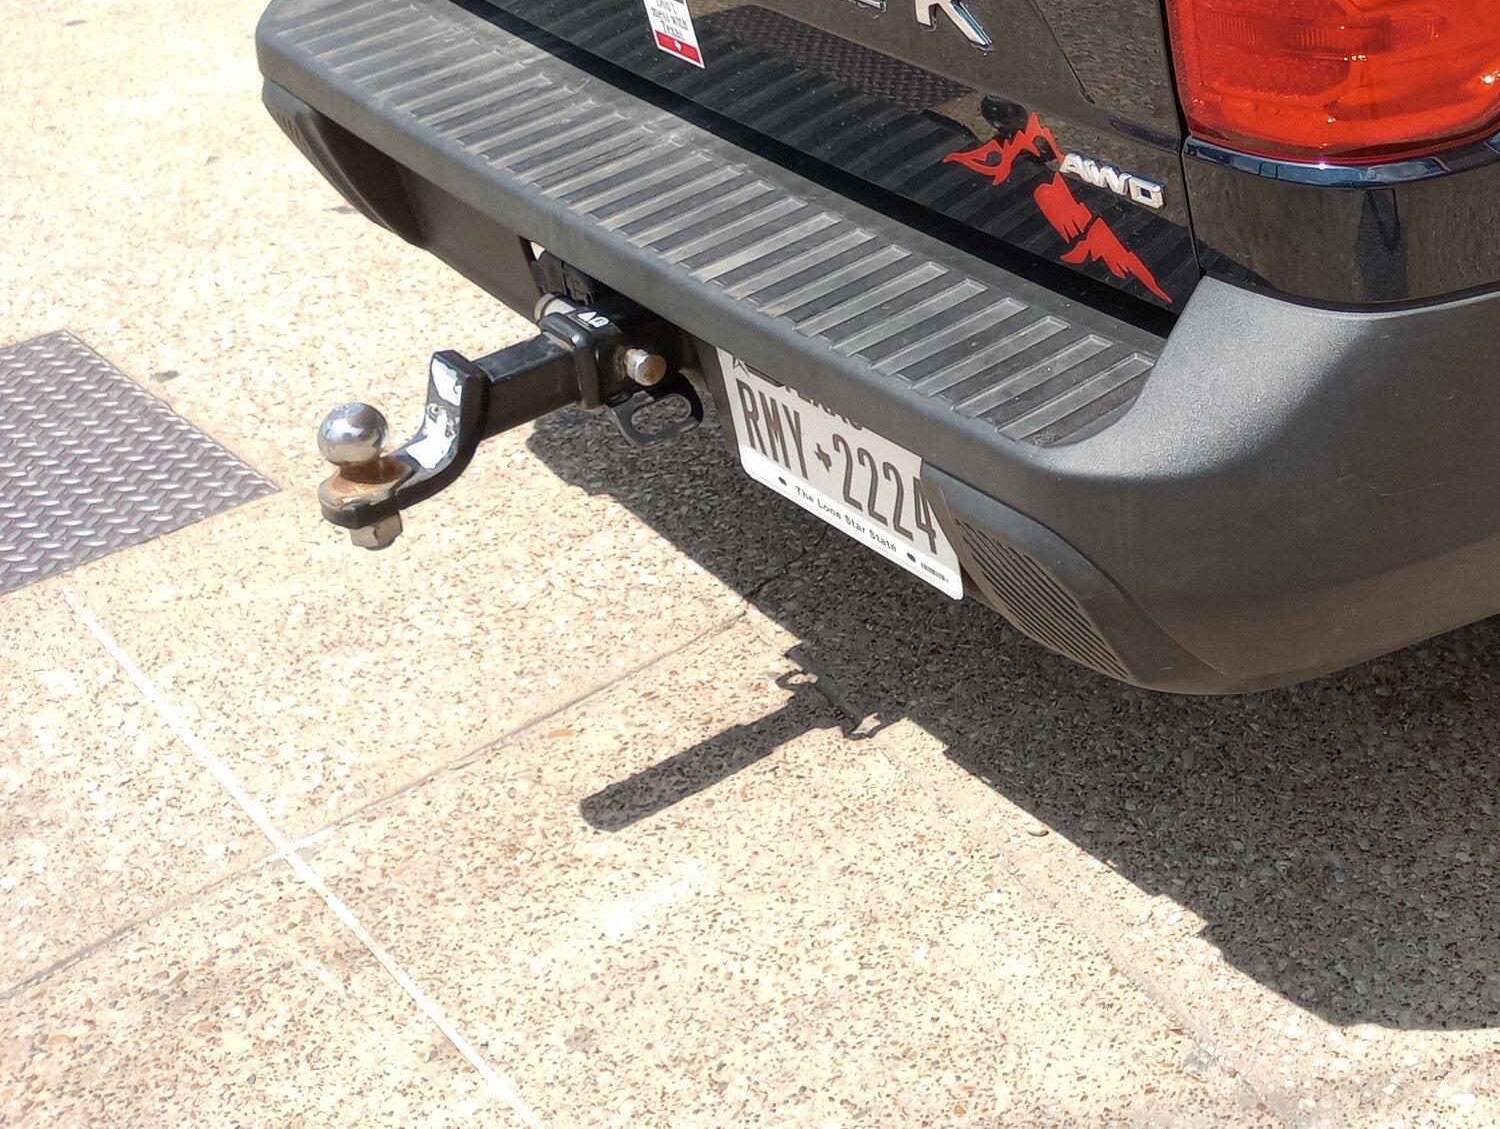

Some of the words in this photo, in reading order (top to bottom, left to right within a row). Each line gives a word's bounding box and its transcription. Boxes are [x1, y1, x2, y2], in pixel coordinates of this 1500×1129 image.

[1059, 151, 1165, 209] AWD
[736, 377, 809, 481] RMY
[832, 433, 938, 556] 2224
[795, 485, 814, 502] The
[817, 497, 842, 520] Lone
[845, 514, 866, 534] Star
[869, 529, 897, 552] State
